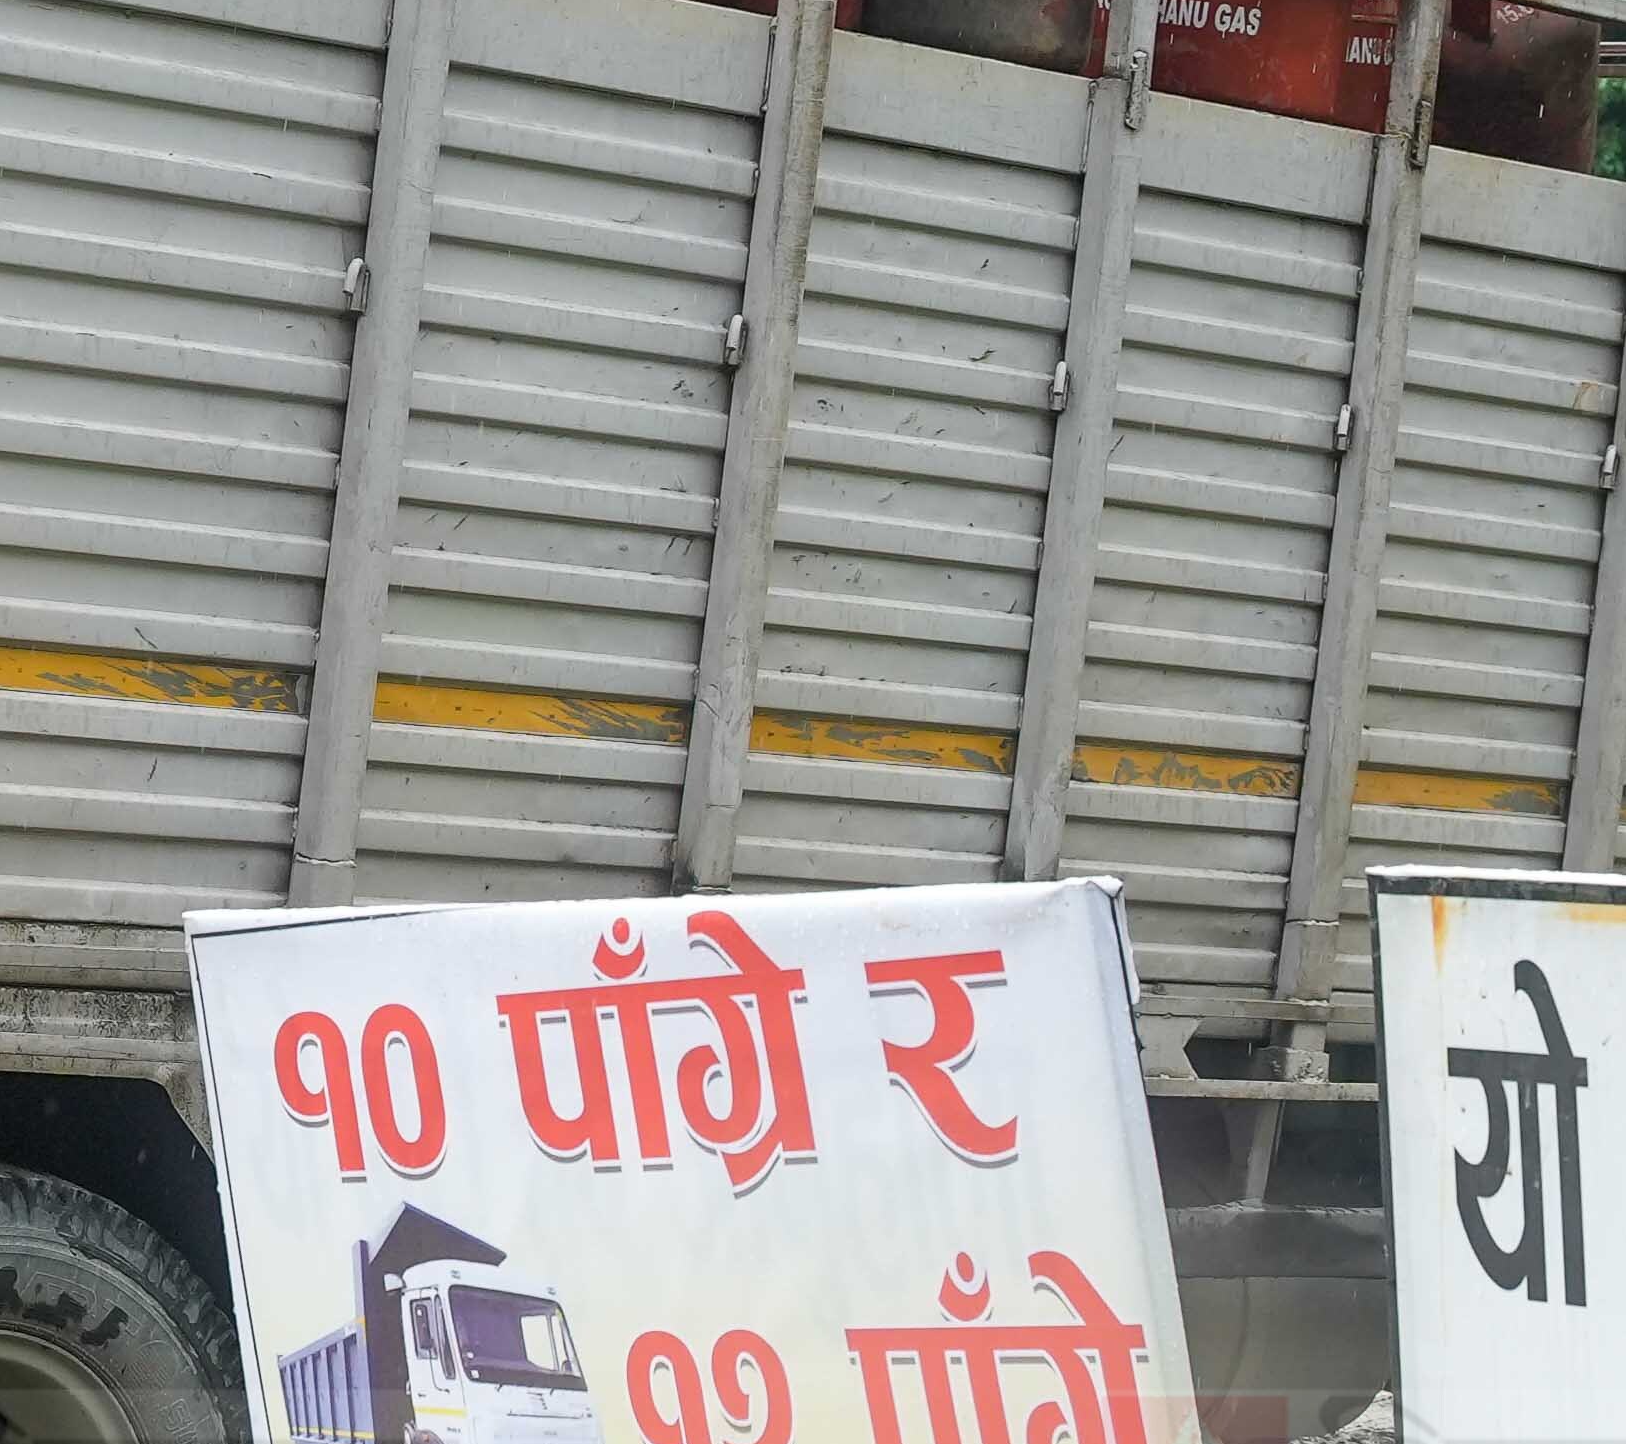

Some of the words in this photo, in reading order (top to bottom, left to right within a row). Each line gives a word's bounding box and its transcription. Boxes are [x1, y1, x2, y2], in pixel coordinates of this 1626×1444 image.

[1214, 4, 1262, 36] GAS
[273, 1002, 448, 1177] १०
[497, 910, 816, 1189] पाँग्रे
[864, 949, 1018, 1159] र
[1447, 959, 1589, 1307] यो
